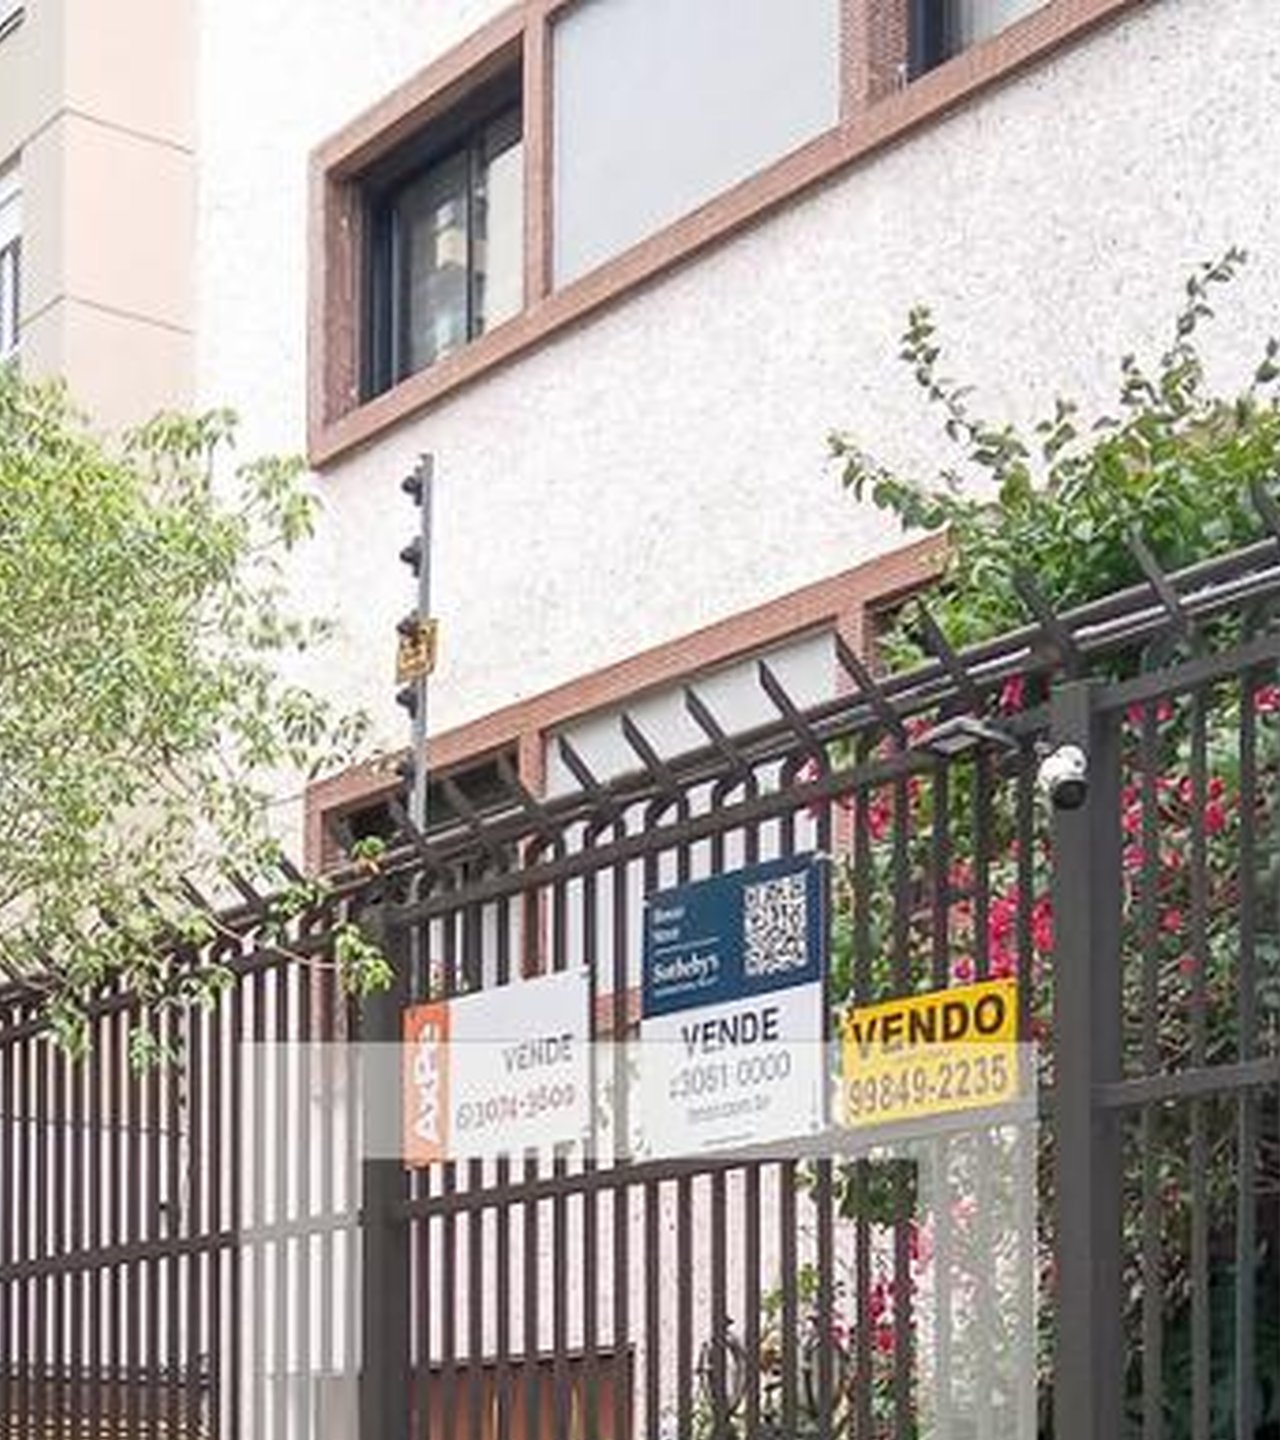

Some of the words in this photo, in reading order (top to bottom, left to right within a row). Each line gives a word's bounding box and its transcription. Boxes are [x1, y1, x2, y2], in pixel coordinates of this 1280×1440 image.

[501, 1032, 574, 1071] VENDE
[681, 1006, 780, 1057] VENDE
[851, 992, 1006, 1059] VENDO
[849, 1052, 1008, 1117] 99849-2235
